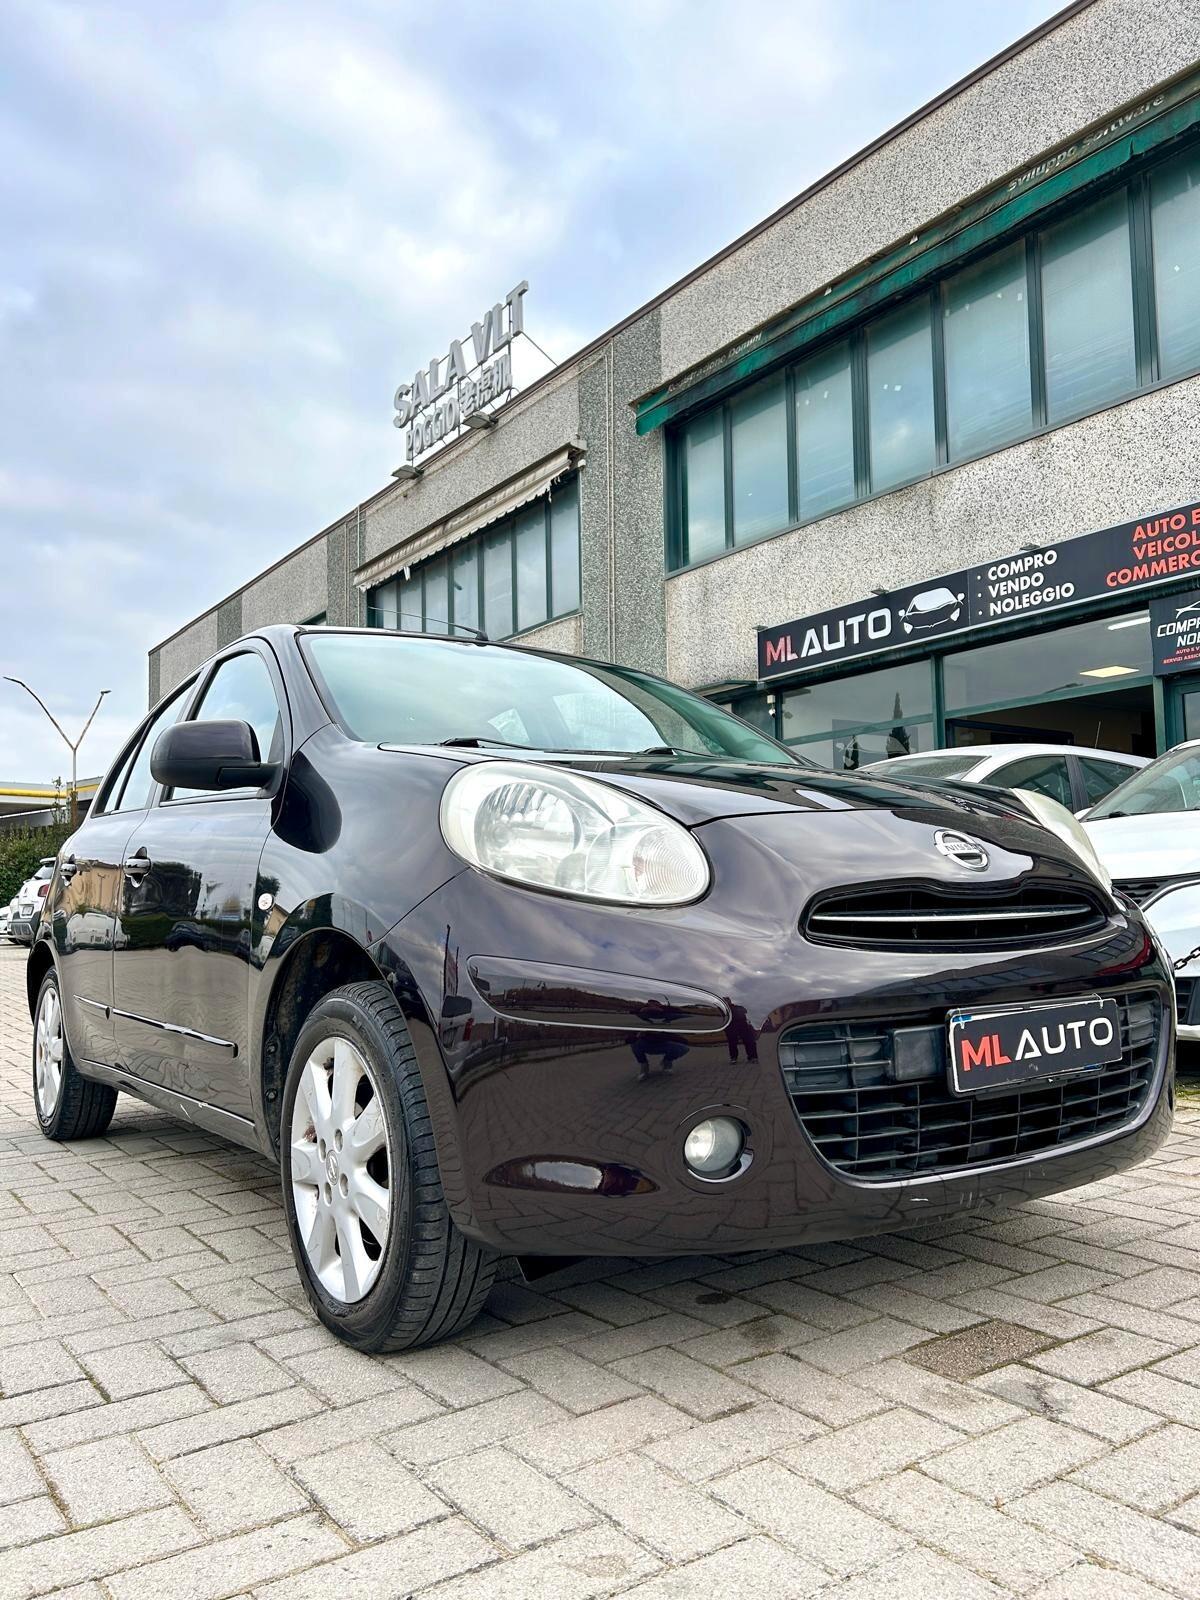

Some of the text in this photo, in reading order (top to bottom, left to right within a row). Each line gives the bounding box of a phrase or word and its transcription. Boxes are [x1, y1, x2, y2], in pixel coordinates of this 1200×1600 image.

[393, 280, 529, 429] SALA VLT
[406, 397, 460, 461] POGGIO
[1132, 508, 1200, 542] AUTO E
[1132, 530, 1200, 560] VEICOL
[987, 550, 1057, 581] COMPRO
[1106, 549, 1200, 587] COMMERC
[988, 572, 1044, 598] VENDO
[989, 582, 1075, 616] NOLEGGIO
